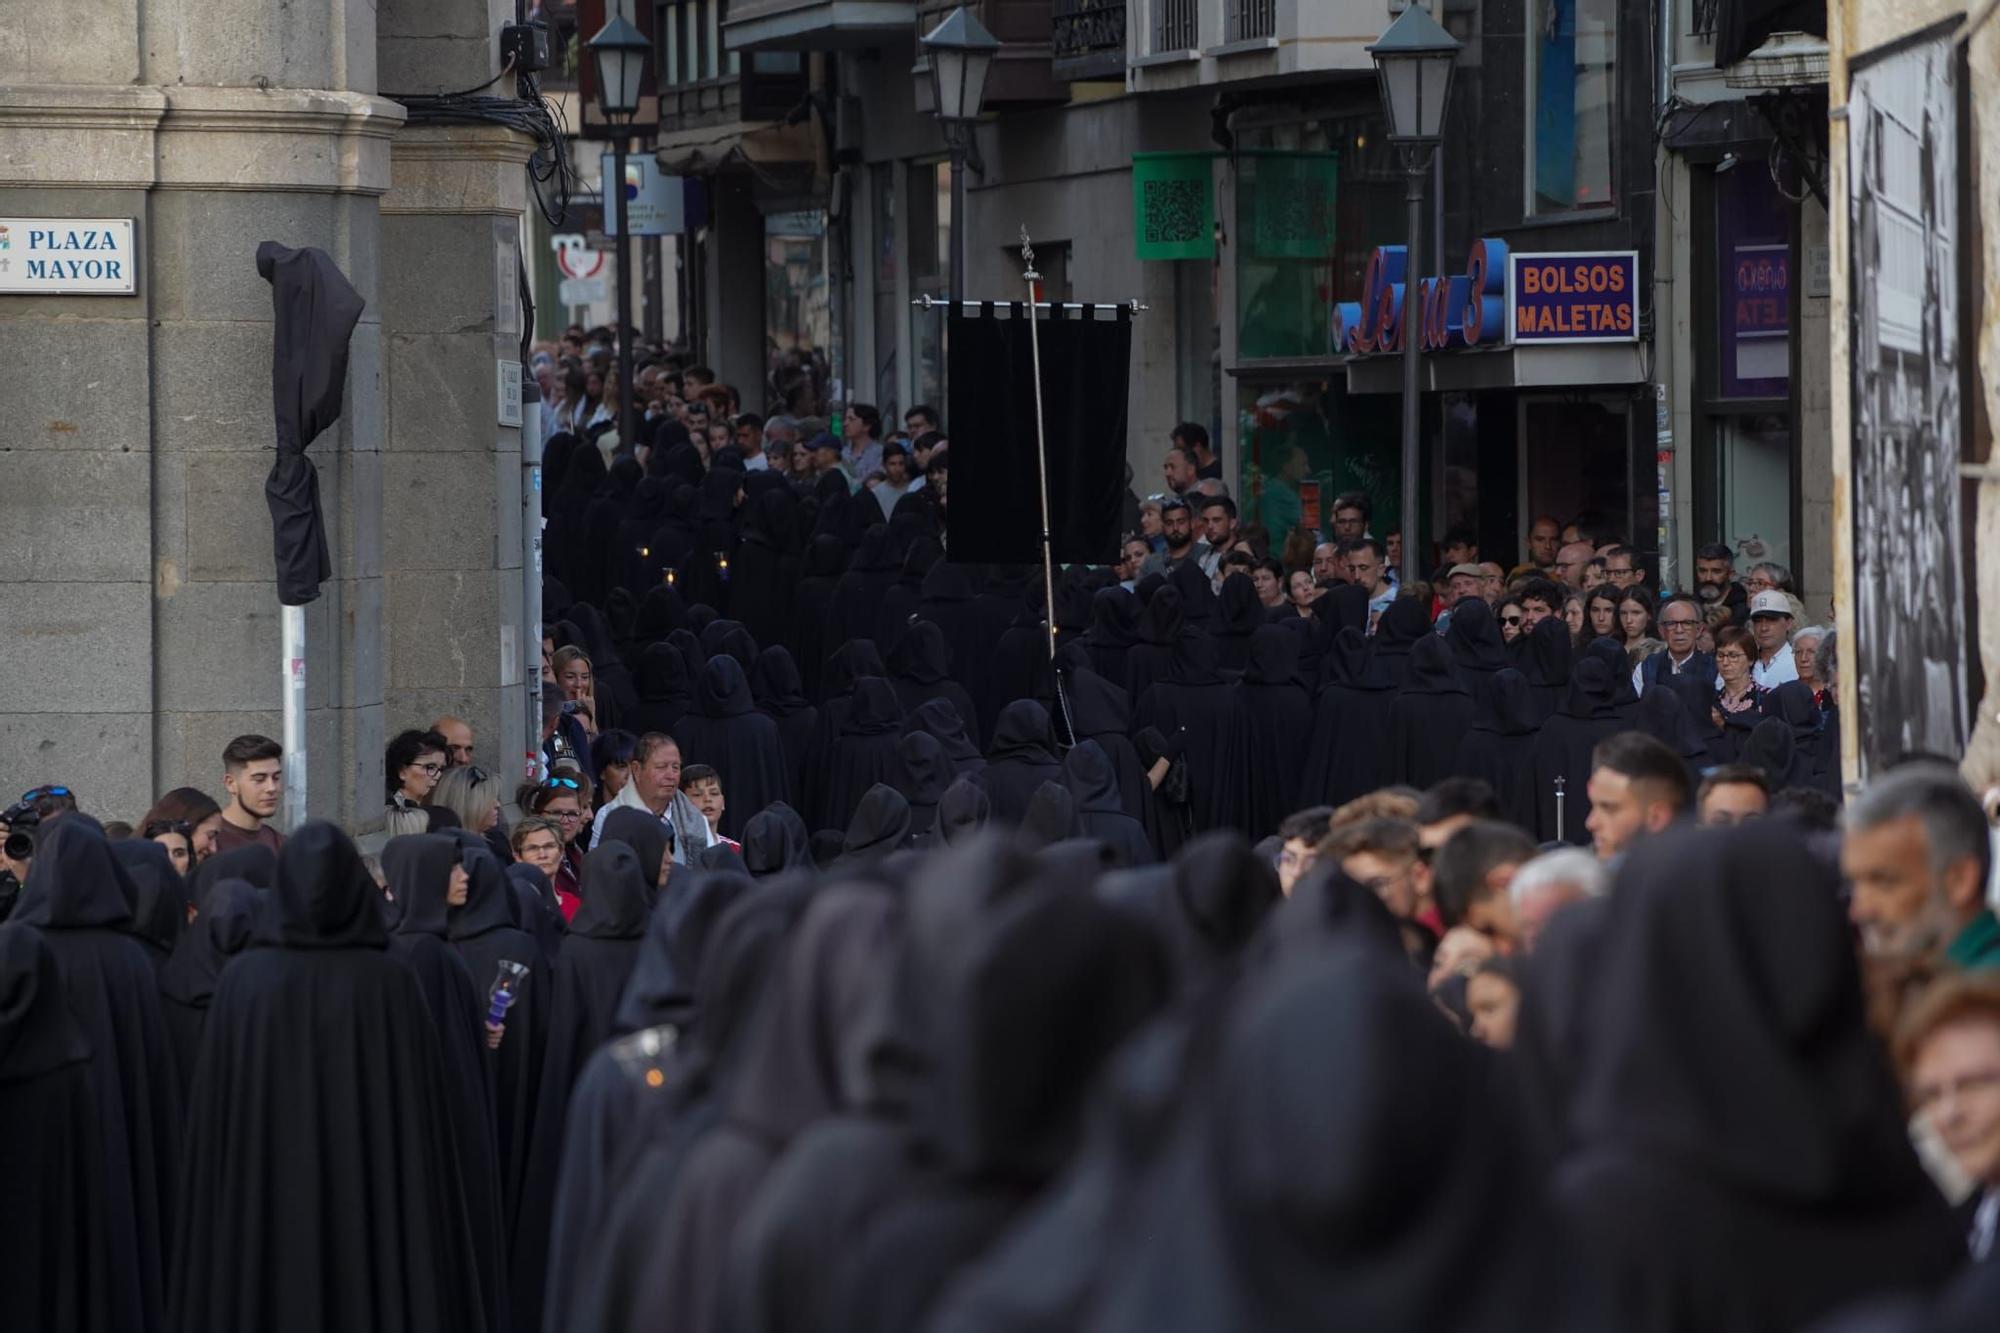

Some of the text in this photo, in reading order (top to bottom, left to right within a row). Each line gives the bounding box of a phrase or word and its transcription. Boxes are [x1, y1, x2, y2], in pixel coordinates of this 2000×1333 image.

[28, 230, 117, 250] PLAZA
[26, 259, 122, 279] MAYOR
[1523, 264, 1625, 294] BOLSOS
[1462, 238, 1493, 345] 3
[1517, 303, 1632, 333] MALETAS
